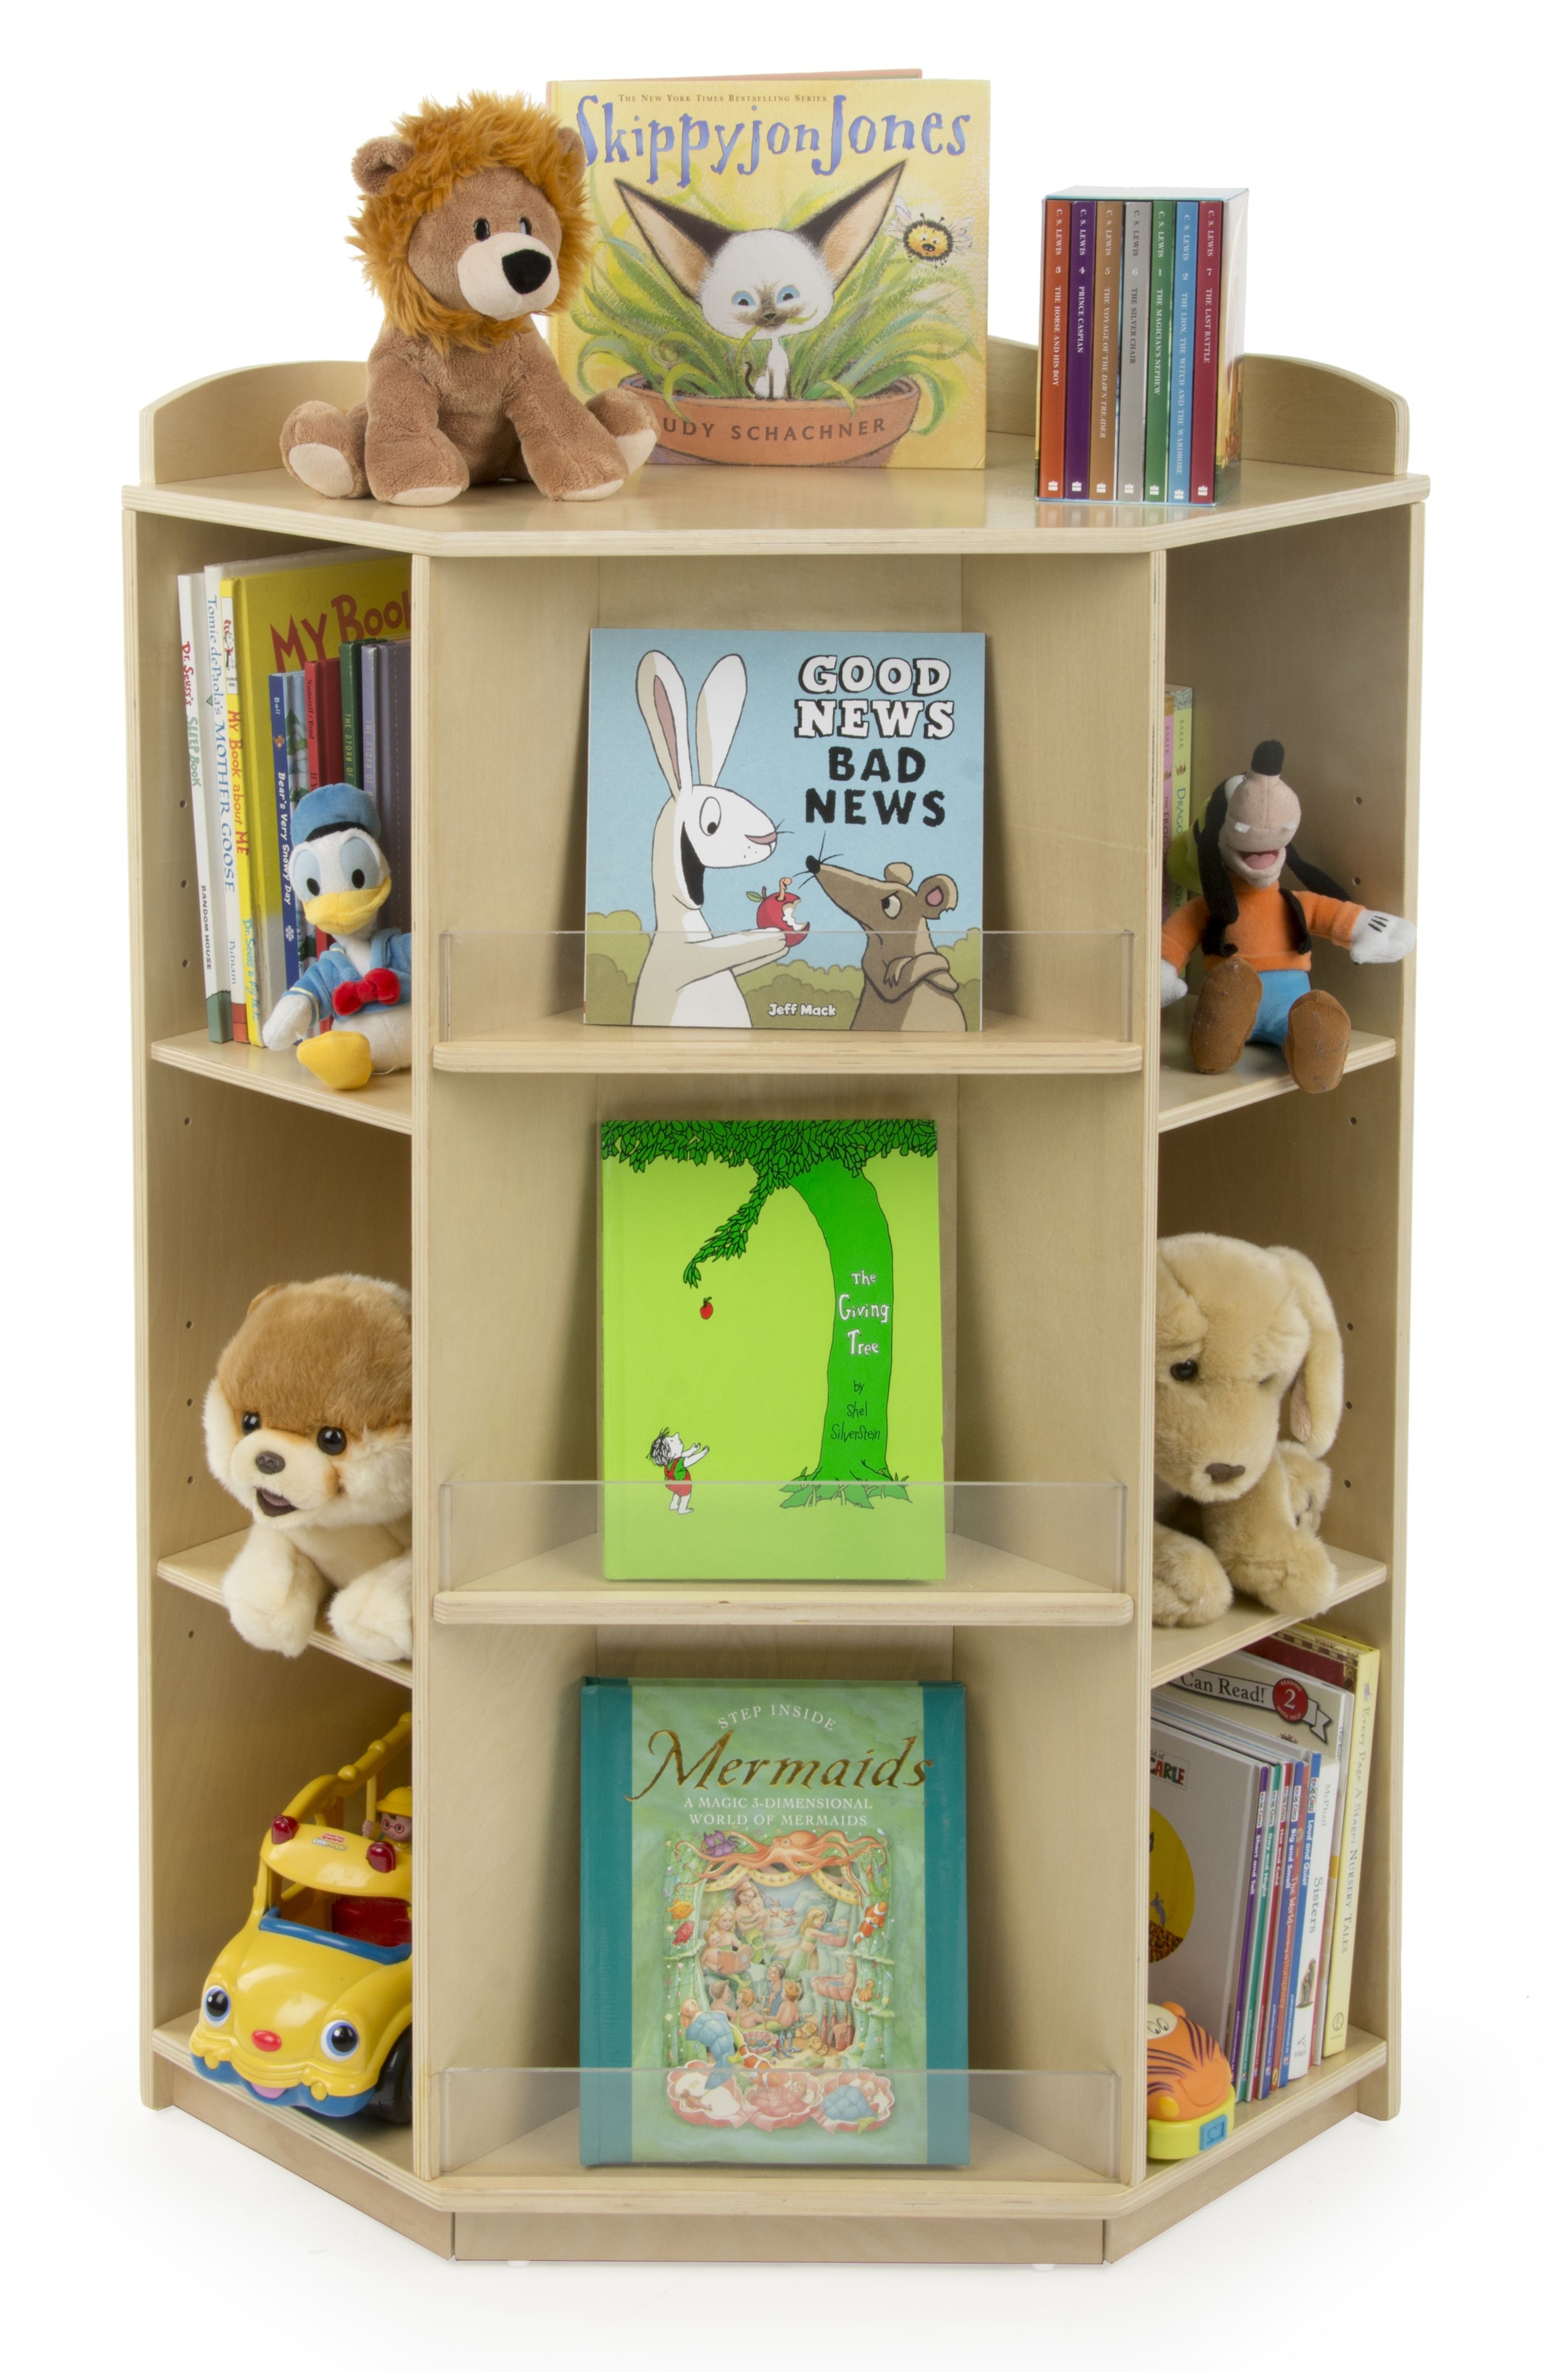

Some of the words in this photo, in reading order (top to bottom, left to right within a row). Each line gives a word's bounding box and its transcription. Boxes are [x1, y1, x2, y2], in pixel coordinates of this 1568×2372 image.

[812, 95, 971, 176] Jones
[1102, 343, 1109, 353] OF
[663, 418, 714, 437] UDY
[731, 418, 885, 441] SCHACHNER
[208, 595, 218, 643] Tomie
[181, 641, 190, 661] Dr.
[183, 665, 194, 706] Seuss's
[211, 647, 224, 715] dePaola's
[798, 655, 951, 696] GOOD
[187, 717, 199, 753] SLEEP
[794, 699, 954, 739] NEWS
[190, 753, 202, 787] BOOK
[215, 719, 230, 816] MOTHER
[346, 767, 353, 777] OF
[828, 746, 925, 783] BAD
[233, 785, 244, 825] about
[278, 772, 287, 809] Bear's
[805, 789, 945, 826] NEWS
[1176, 788, 1186, 834] DRAGO
[222, 823, 235, 892] GOOSE
[235, 831, 249, 856] ME
[243, 918, 252, 936] Dr.
[767, 1003, 797, 1017] Jeff
[800, 1003, 837, 1017] Mack
[851, 1269, 876, 1286] The
[839, 1293, 889, 1323] Giving
[847, 1328, 878, 1356] Tree
[854, 1380, 865, 1395] by
[846, 1401, 867, 1418] Shel
[1218, 1677, 1264, 1703] Read!
[1280, 1680, 1302, 1692] READING
[1284, 1689, 1296, 1709] 2
[718, 1706, 762, 1730] STEP
[771, 1704, 837, 1731] INSIDE
[1359, 1707, 1370, 1746] Every
[623, 1729, 933, 1802] Mermaids
[1355, 1752, 1366, 1782] Page
[684, 1798, 692, 1808] A
[698, 1797, 748, 1809] MAGIC
[752, 1798, 872, 1809] 3-DIMENSIONAL
[1321, 1784, 1331, 1826] McPhail
[1355, 1788, 1363, 1799] A
[690, 1814, 750, 1826] WORLD
[754, 1814, 774, 1825] OF
[781, 1815, 868, 1826] MERMAIDS
[1289, 1875, 1298, 1896] The
[1346, 1849, 1357, 1908] NURSERY
[1310, 1877, 1324, 1934] Sisters
[1341, 1913, 1352, 1953] TALES
